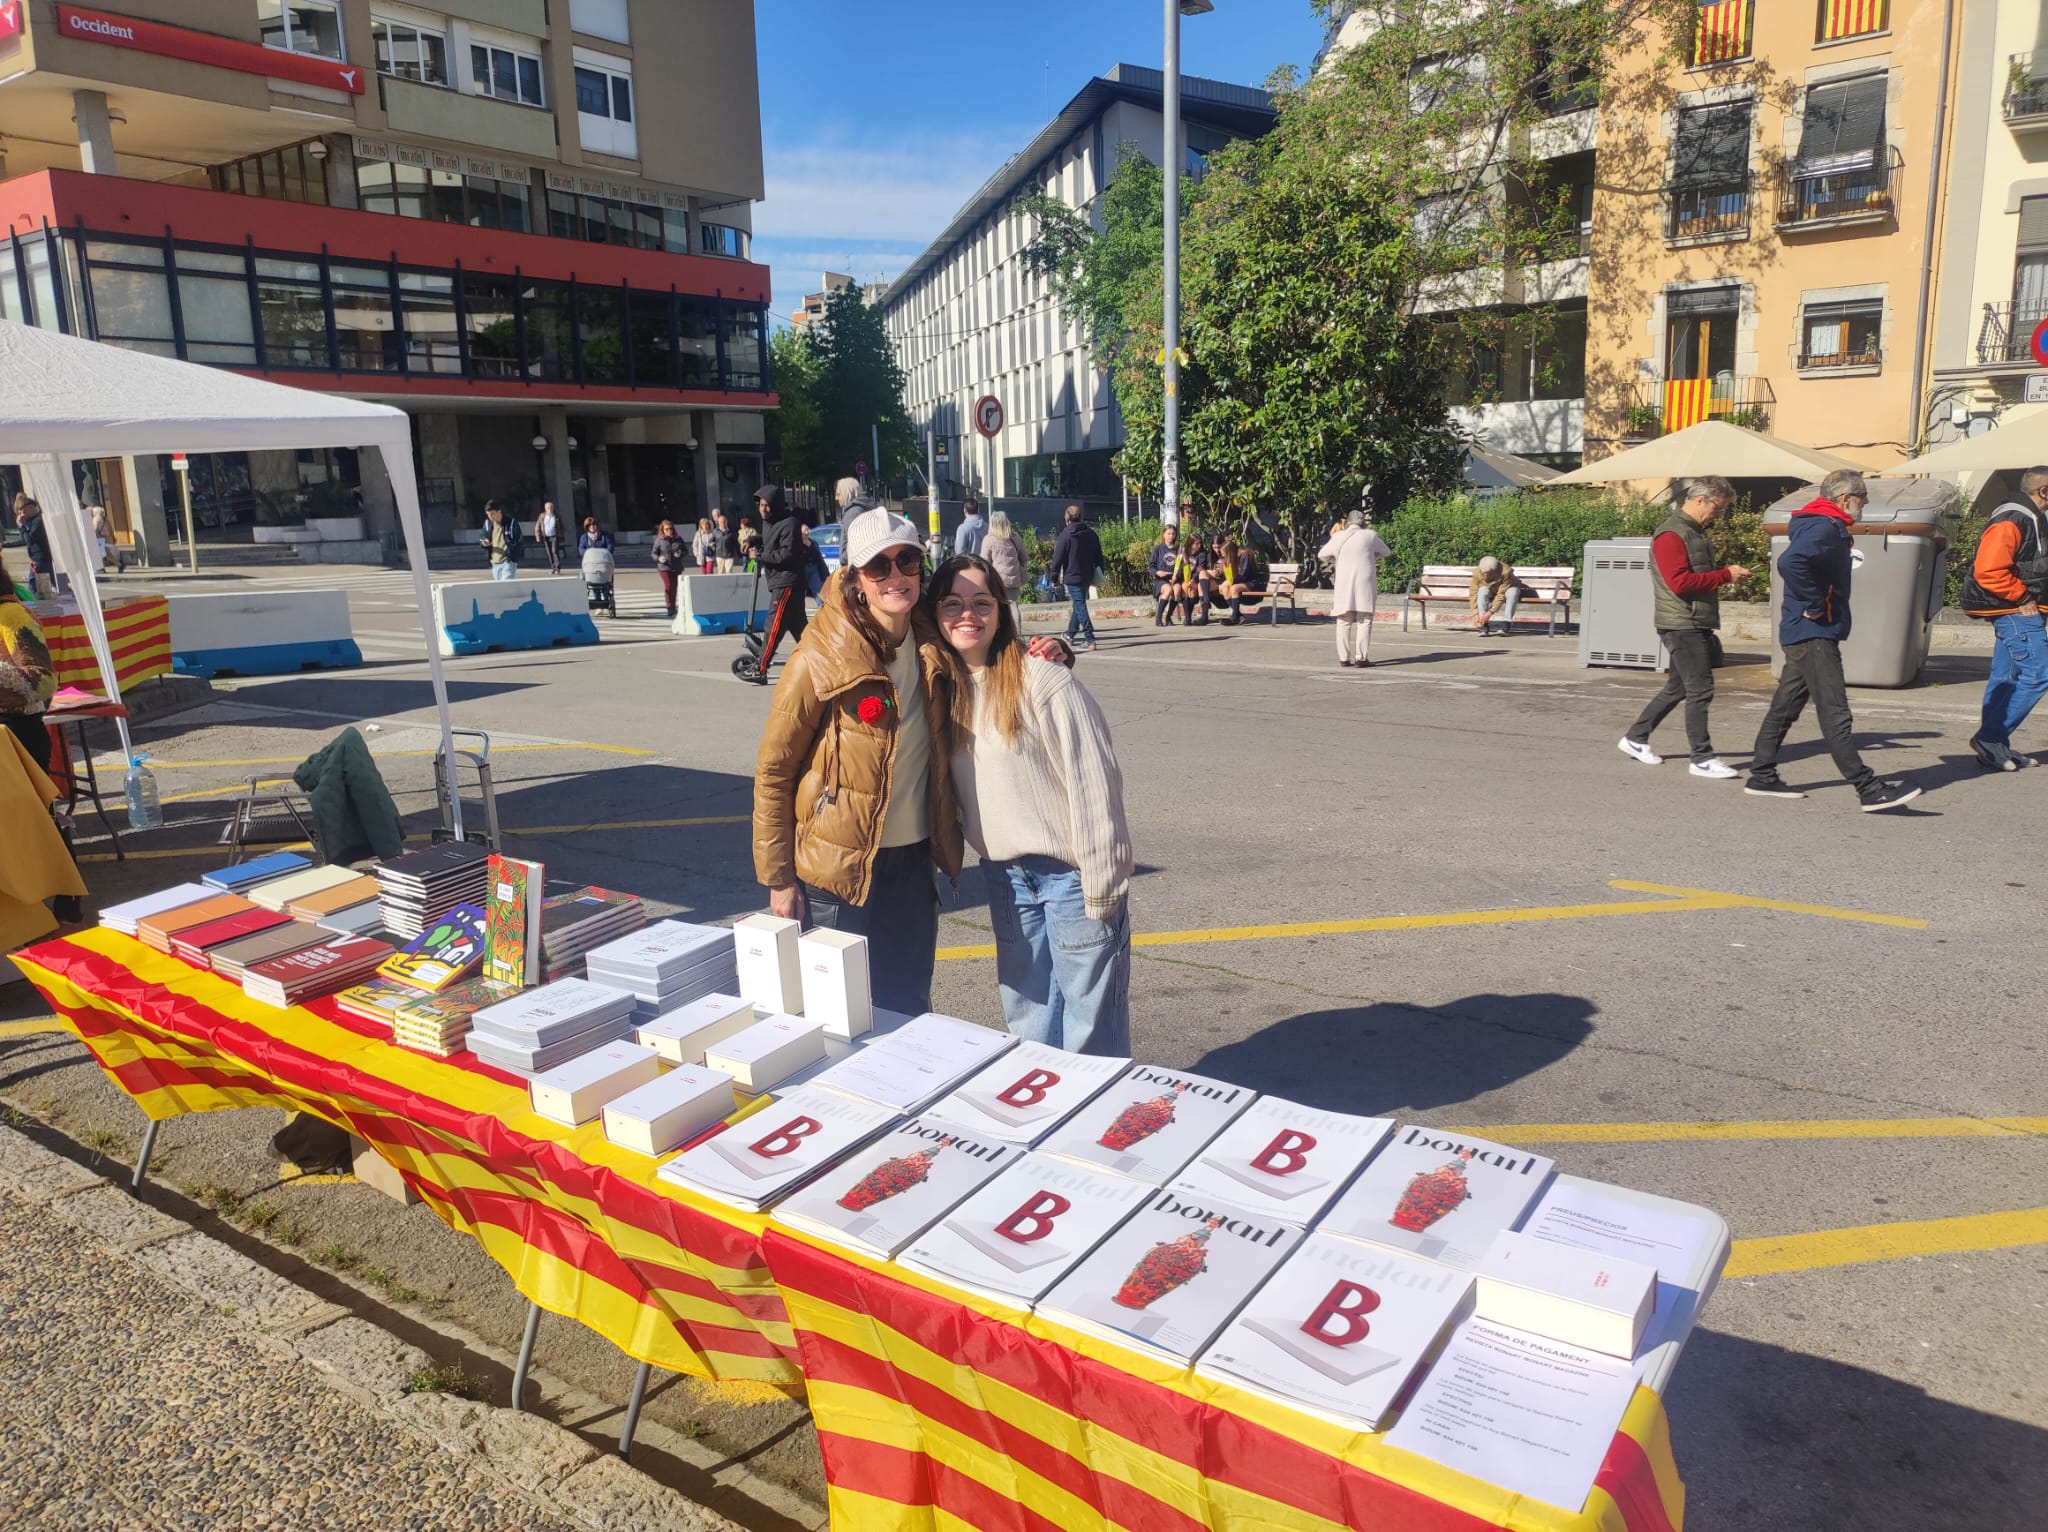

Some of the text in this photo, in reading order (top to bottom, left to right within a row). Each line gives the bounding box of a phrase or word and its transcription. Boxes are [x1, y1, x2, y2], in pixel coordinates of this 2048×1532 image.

[70, 15, 134, 40] Occident
[1000, 1068, 1061, 1108] B
[748, 1115, 823, 1160] B
[1249, 1128, 1317, 1177] B
[994, 1189, 1072, 1244] B
[1550, 1206, 1628, 1231] PREUS/PRECIOS
[1300, 1279, 1381, 1349] B
[1472, 1324, 1591, 1364] FORMA DE PAGAMENT
